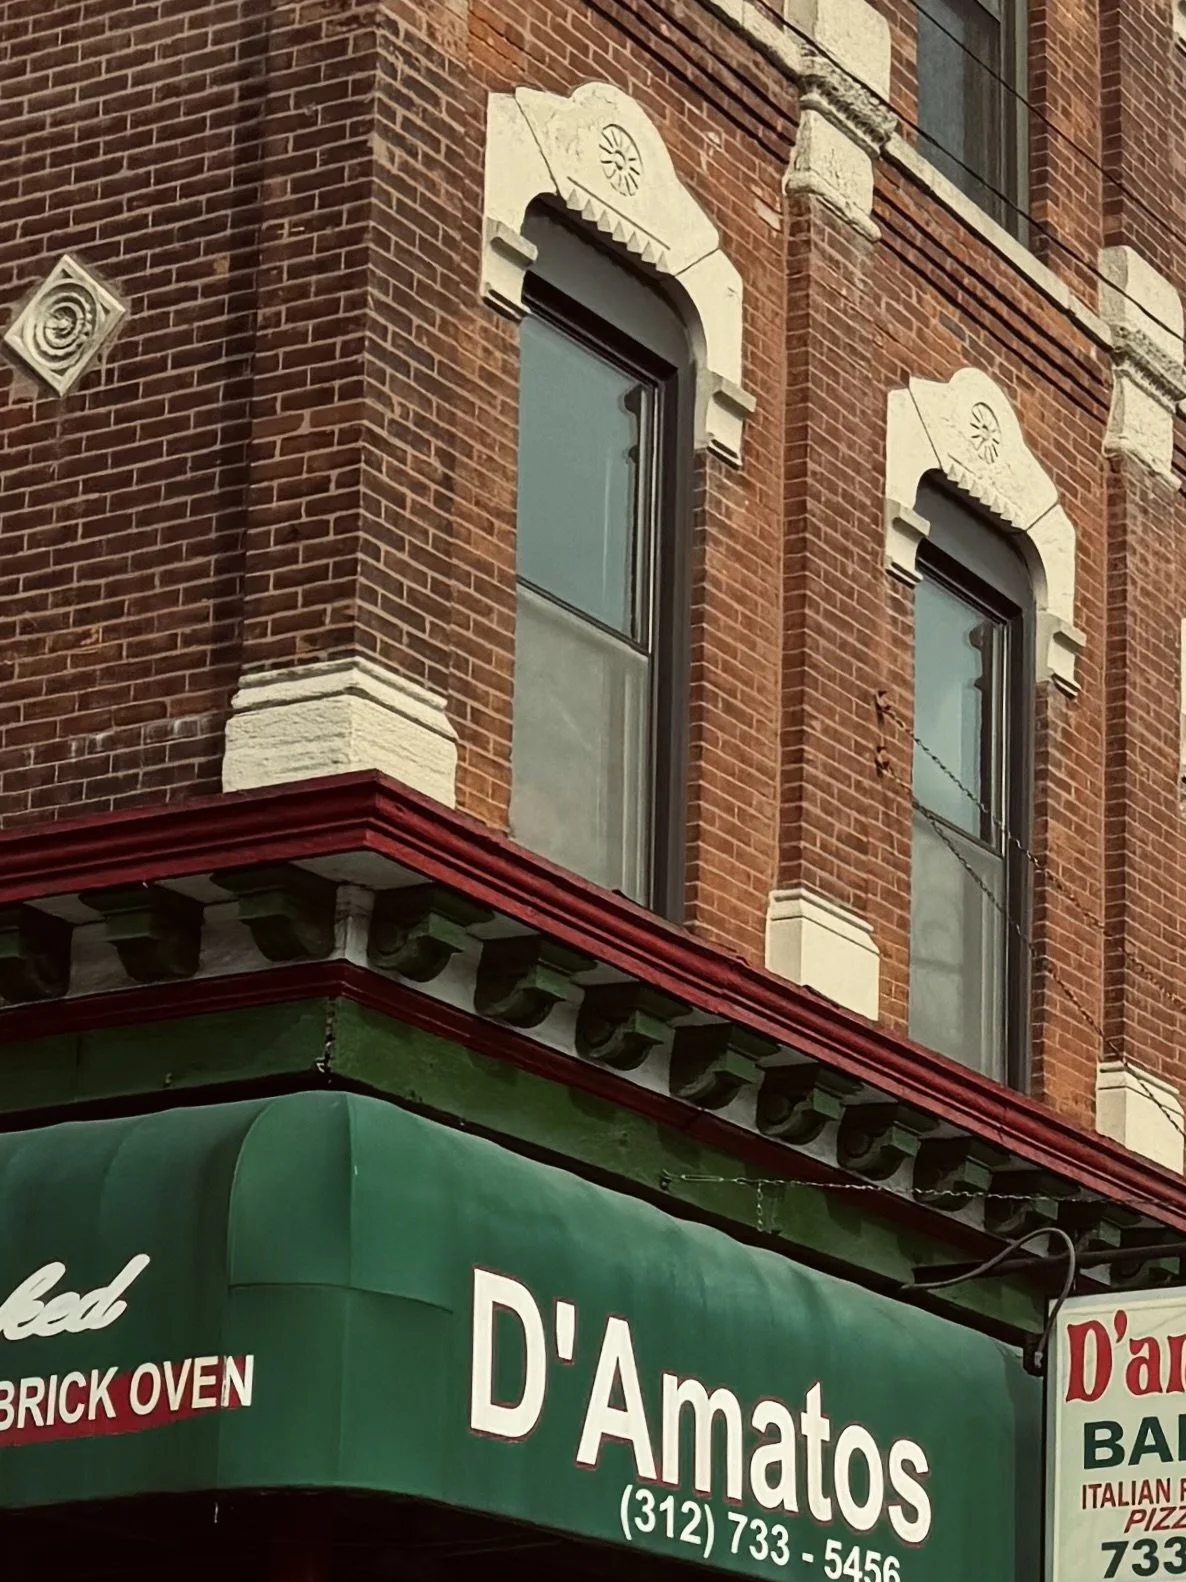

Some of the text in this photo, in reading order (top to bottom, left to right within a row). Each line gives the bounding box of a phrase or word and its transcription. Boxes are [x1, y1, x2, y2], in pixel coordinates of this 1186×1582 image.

[129, 1354, 255, 1416] OVEN
[470, 1266, 932, 1545] D'Amatos
[620, 1484, 716, 1559] (312)
[726, 1512, 791, 1567] 733
[1082, 1477, 1171, 1510] ITALIAN
